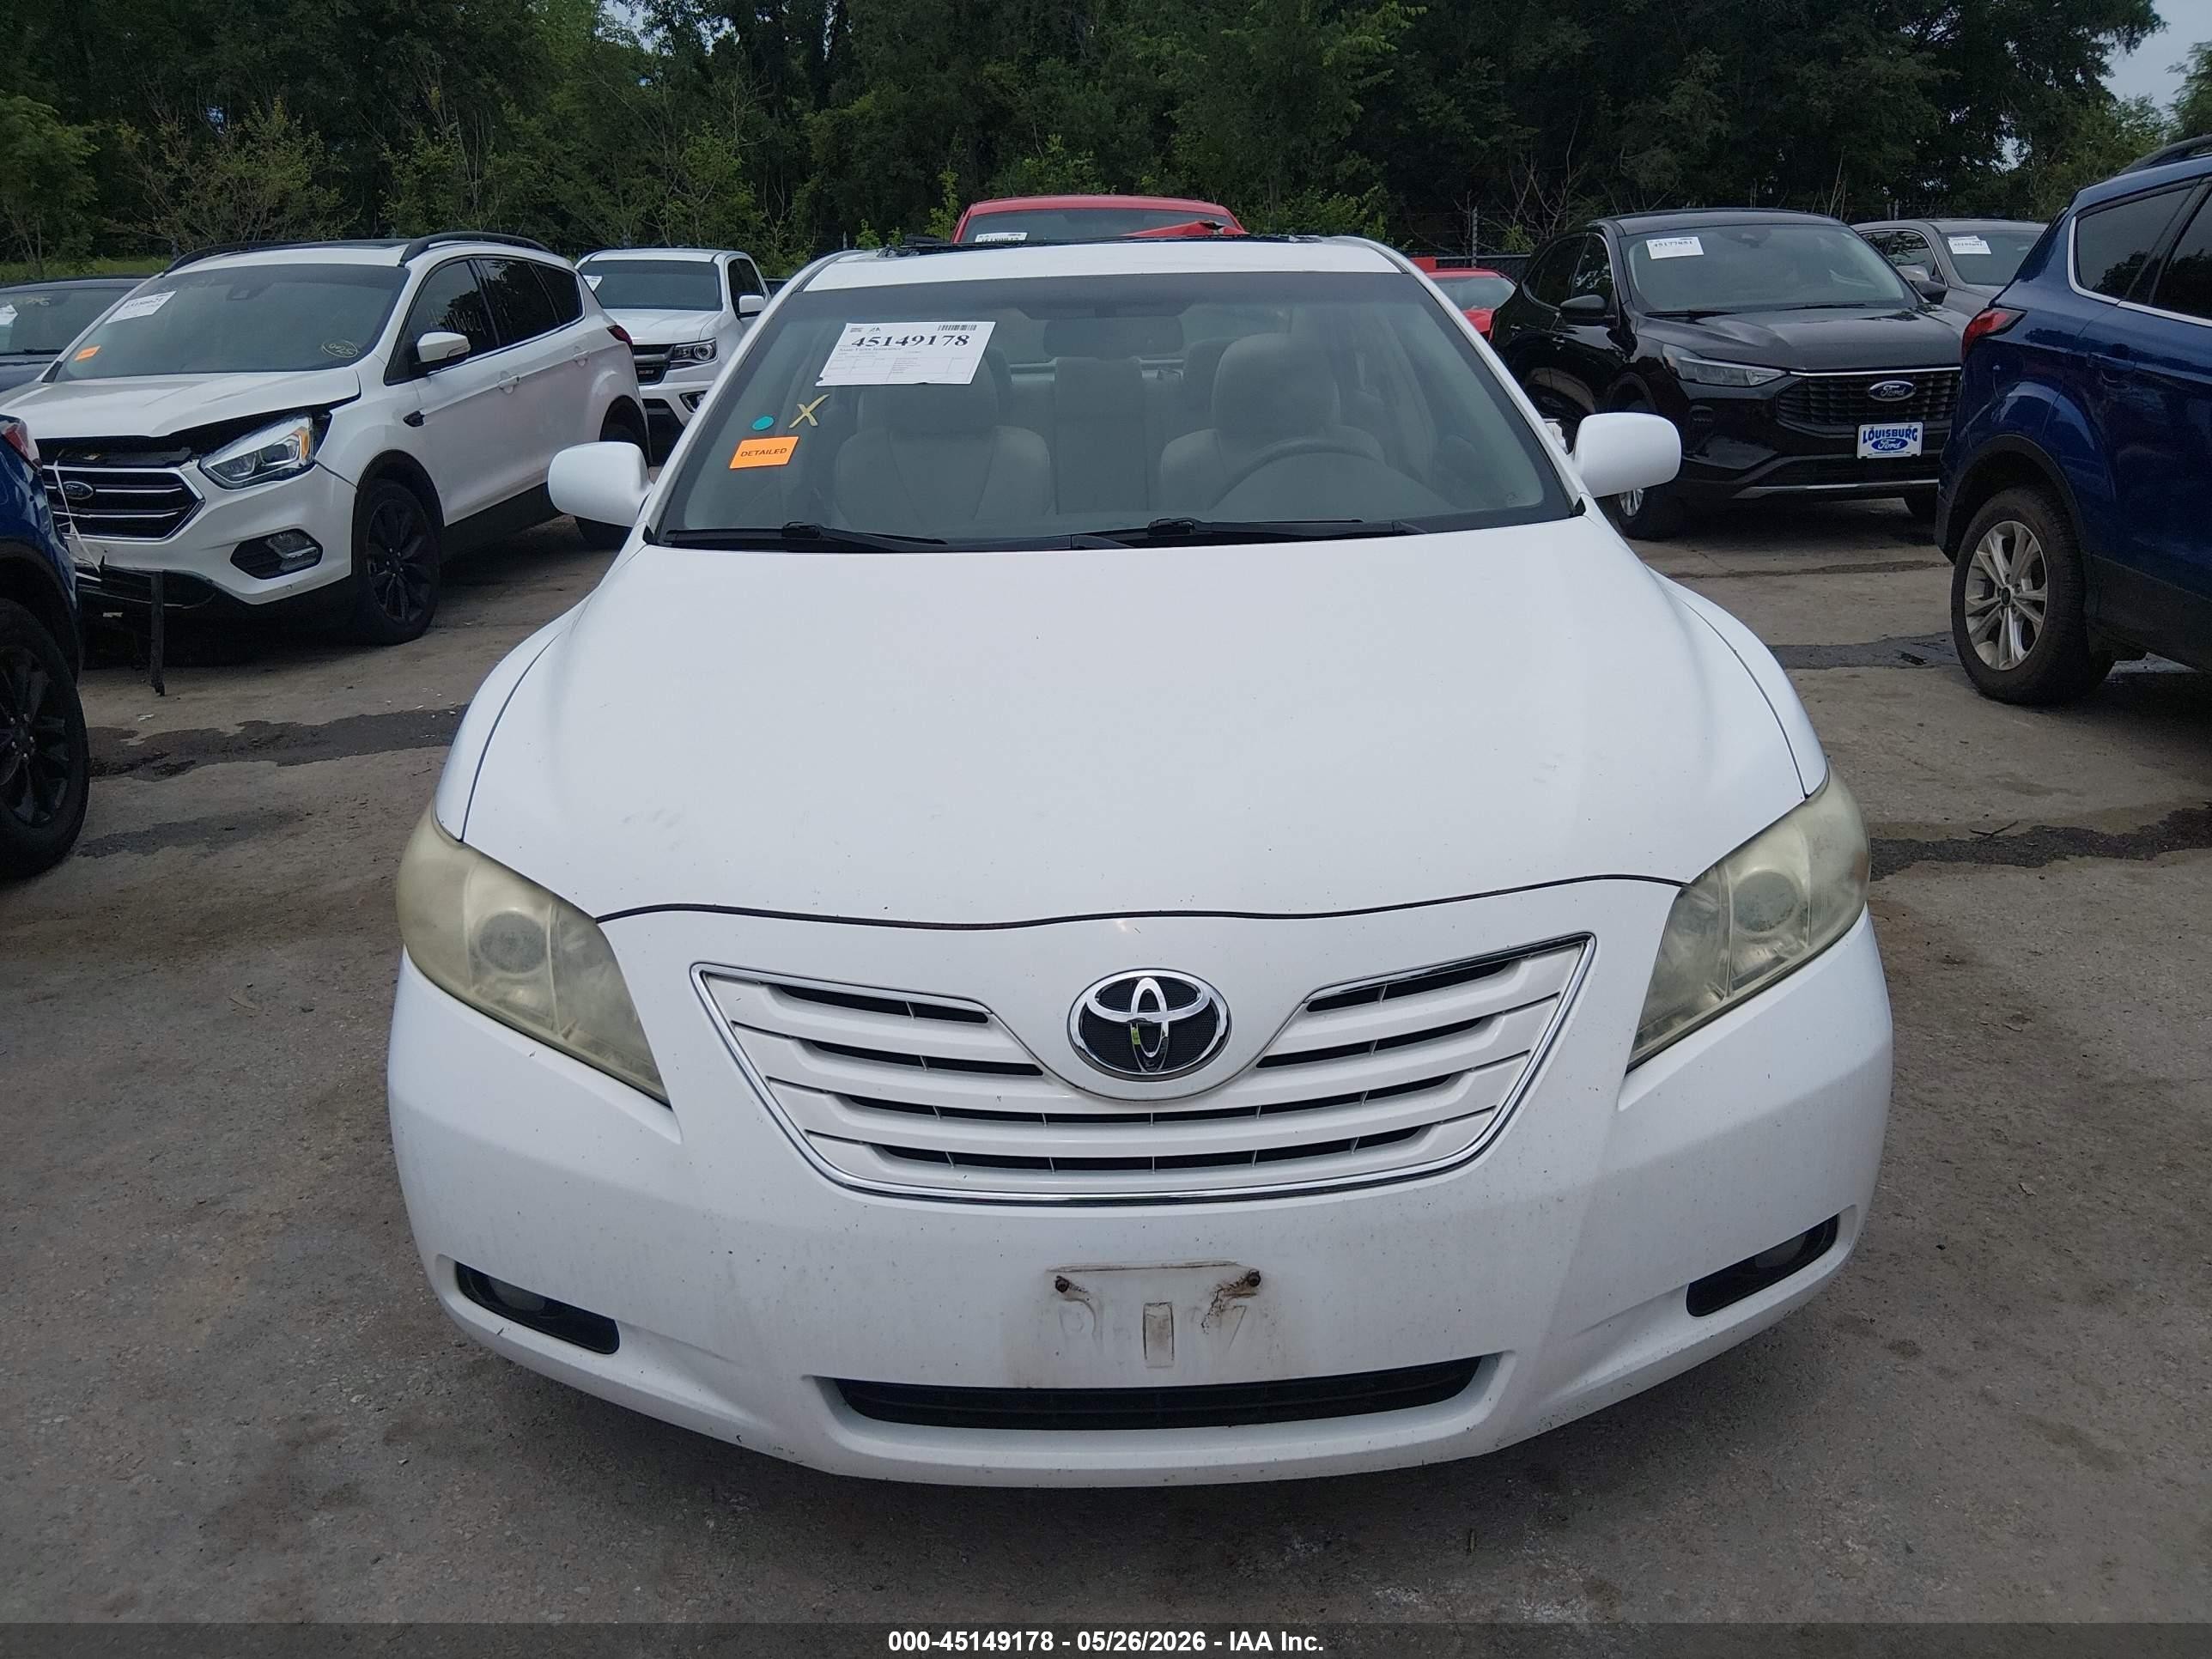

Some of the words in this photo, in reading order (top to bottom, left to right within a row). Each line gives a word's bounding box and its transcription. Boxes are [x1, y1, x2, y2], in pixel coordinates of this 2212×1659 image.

[851, 334, 969, 347] 45149178
[1881, 385, 1906, 397] Ford
[1863, 427, 1918, 444] LOUISBURG
[1877, 438, 1903, 450] Ford
[740, 447, 787, 457] DETAILED
